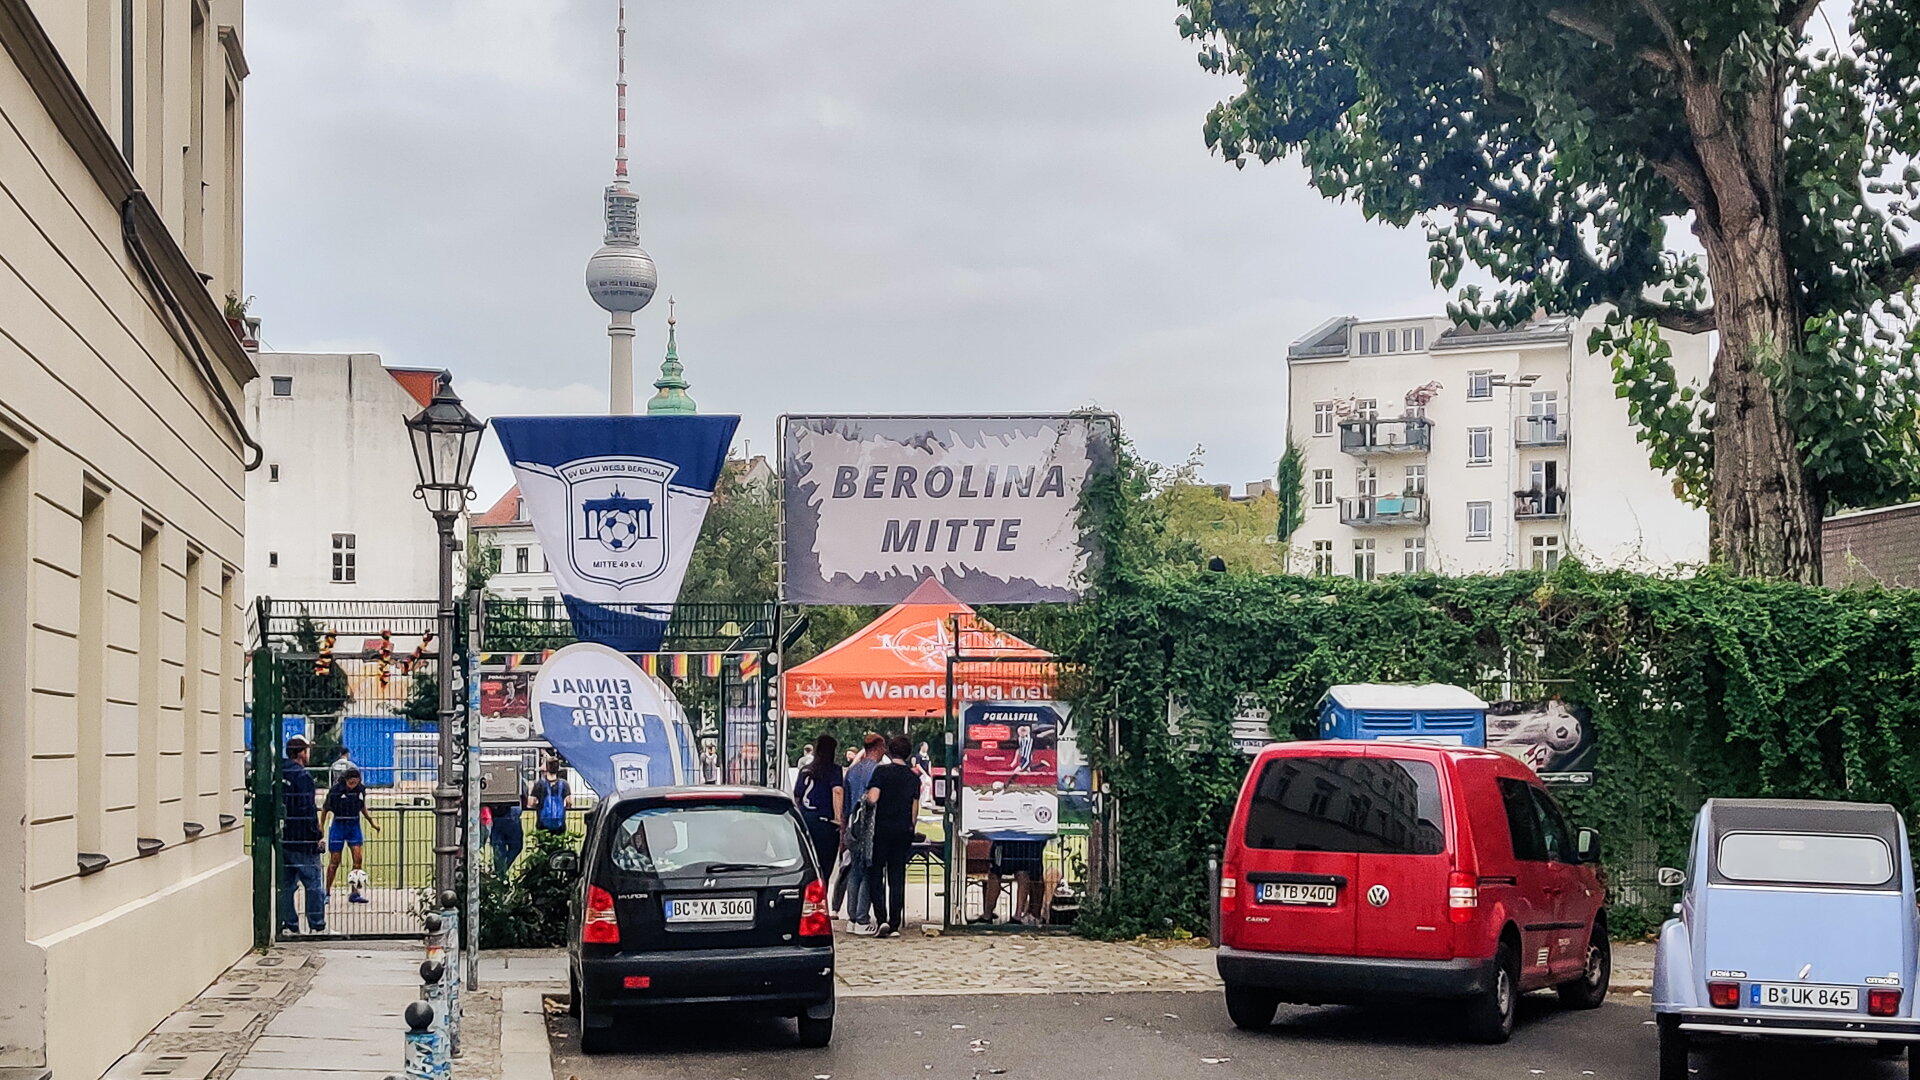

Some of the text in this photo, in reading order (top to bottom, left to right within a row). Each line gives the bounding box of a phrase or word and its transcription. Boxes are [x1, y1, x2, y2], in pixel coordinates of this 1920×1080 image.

[580, 465, 600, 475] BLAU
[602, 464, 626, 472] WEISS
[627, 465, 665, 478] BEROLINA
[831, 465, 1066, 499] BEROLINA
[881, 518, 1022, 553] MITTE
[593, 560, 618, 569] MITTE
[1264, 884, 1335, 901] B TB 9400
[674, 900, 752, 916] BC XA 3060
[1768, 988, 1851, 1007] B UK 845
